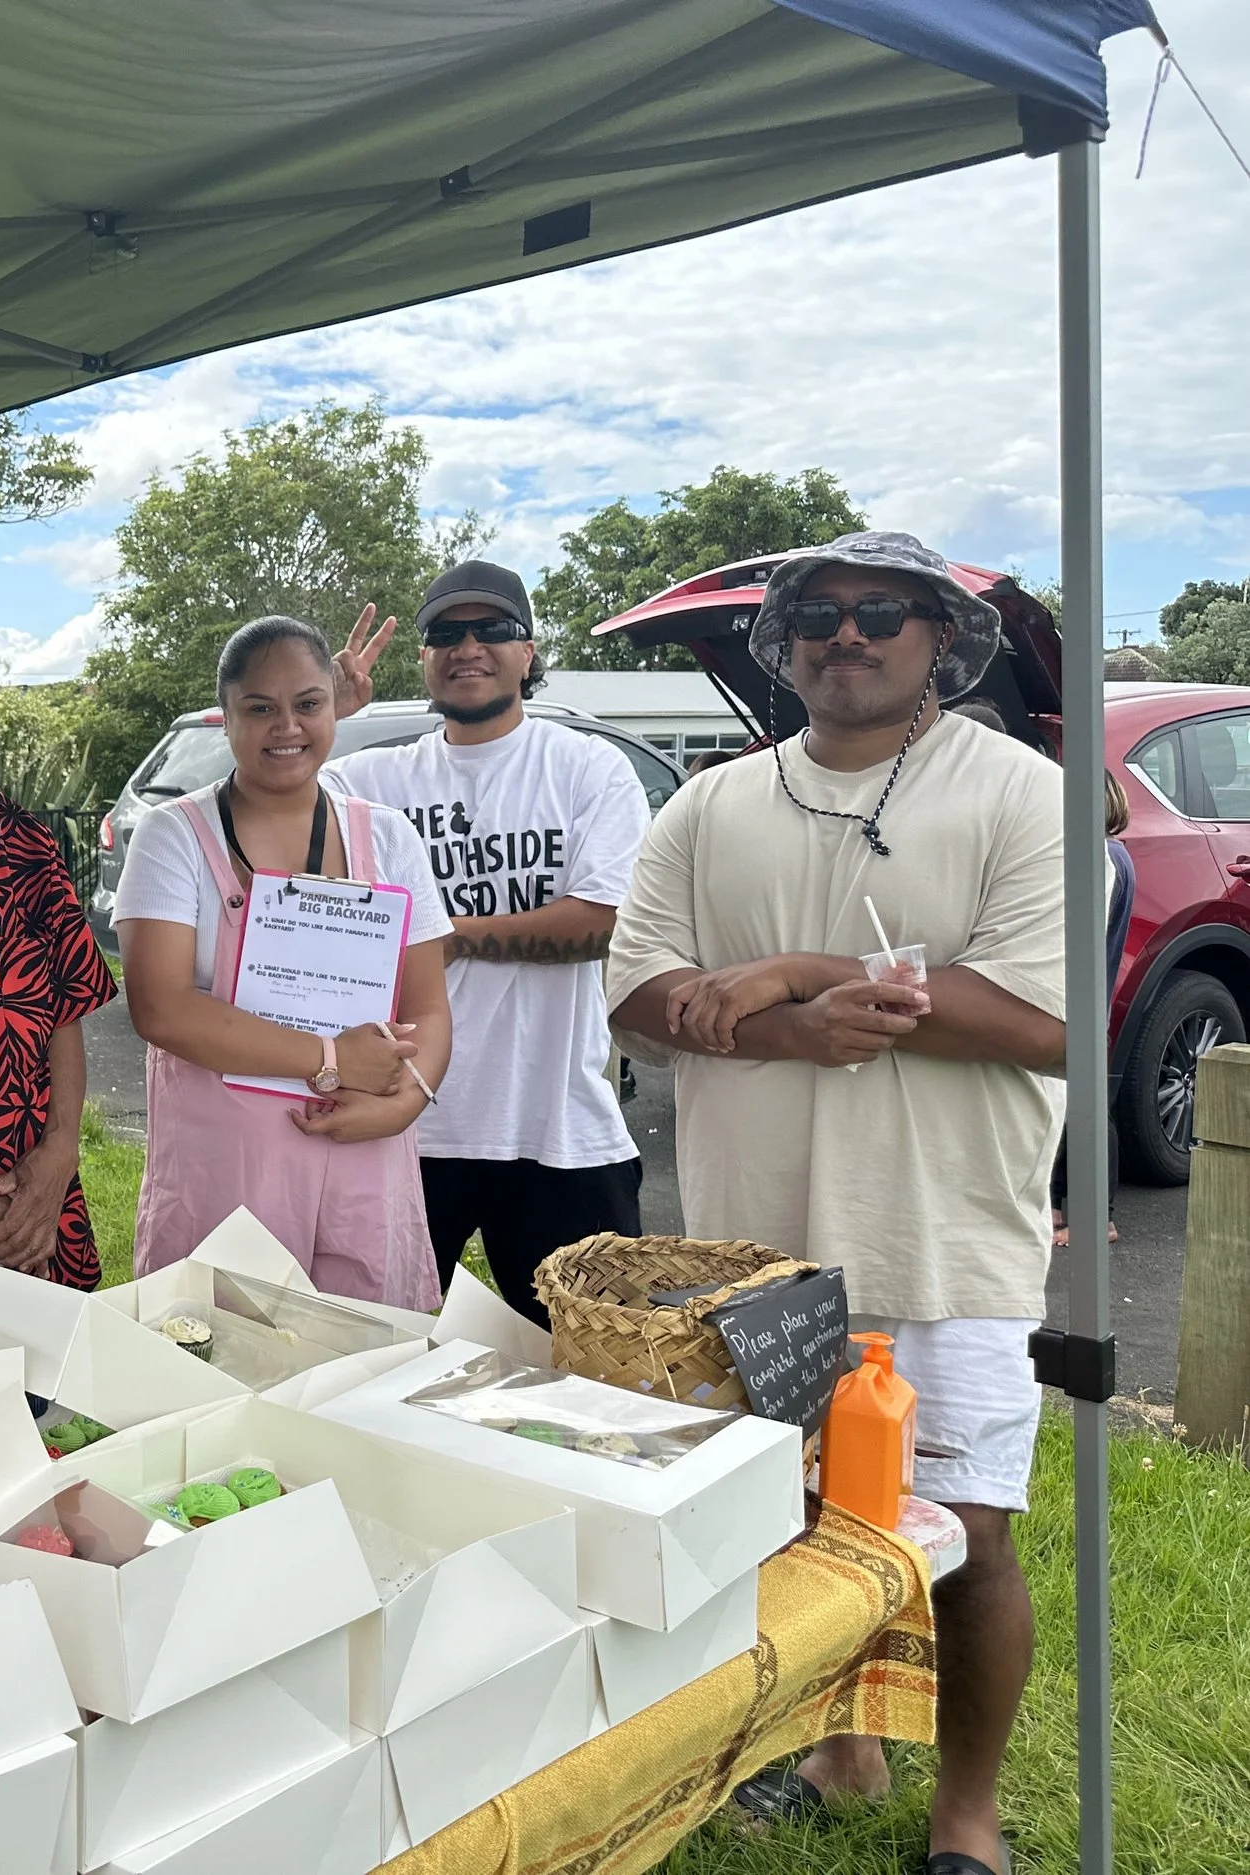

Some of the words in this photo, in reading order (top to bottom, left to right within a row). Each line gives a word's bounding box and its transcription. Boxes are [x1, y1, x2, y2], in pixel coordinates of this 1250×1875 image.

[403, 803, 445, 839] HE
[431, 829, 563, 880] UTHSIDE
[300, 892, 352, 907] PANAMA'S
[298, 901, 322, 914] BIG
[326, 905, 391, 925] BACKYARD
[264, 923, 295, 932] BACKYARD?
[271, 917, 287, 925] WHAT
[311, 922, 324, 930] LIKE
[325, 925, 344, 934] ABOUT
[345, 928, 373, 938] PANAMA'S
[375, 932, 386, 940] BIG
[264, 964, 280, 972] WHAT
[281, 967, 301, 975] WOULD
[303, 970, 315, 978] YOU
[316, 972, 329, 980] LIKE
[338, 975, 348, 983] SEE
[358, 979, 387, 989] PANAMA'S
[268, 971, 297, 981] BACKYARD
[258, 1011, 275, 1019] WHAT
[276, 1013, 294, 1022] COULD
[295, 1016, 310, 1025] MAKE
[311, 1020, 340, 1030] PANAMA'S
[297, 1023, 319, 1033] BETTER?
[730, 1328, 777, 1361] Please
[780, 1310, 810, 1344] place
[814, 1295, 837, 1329] your
